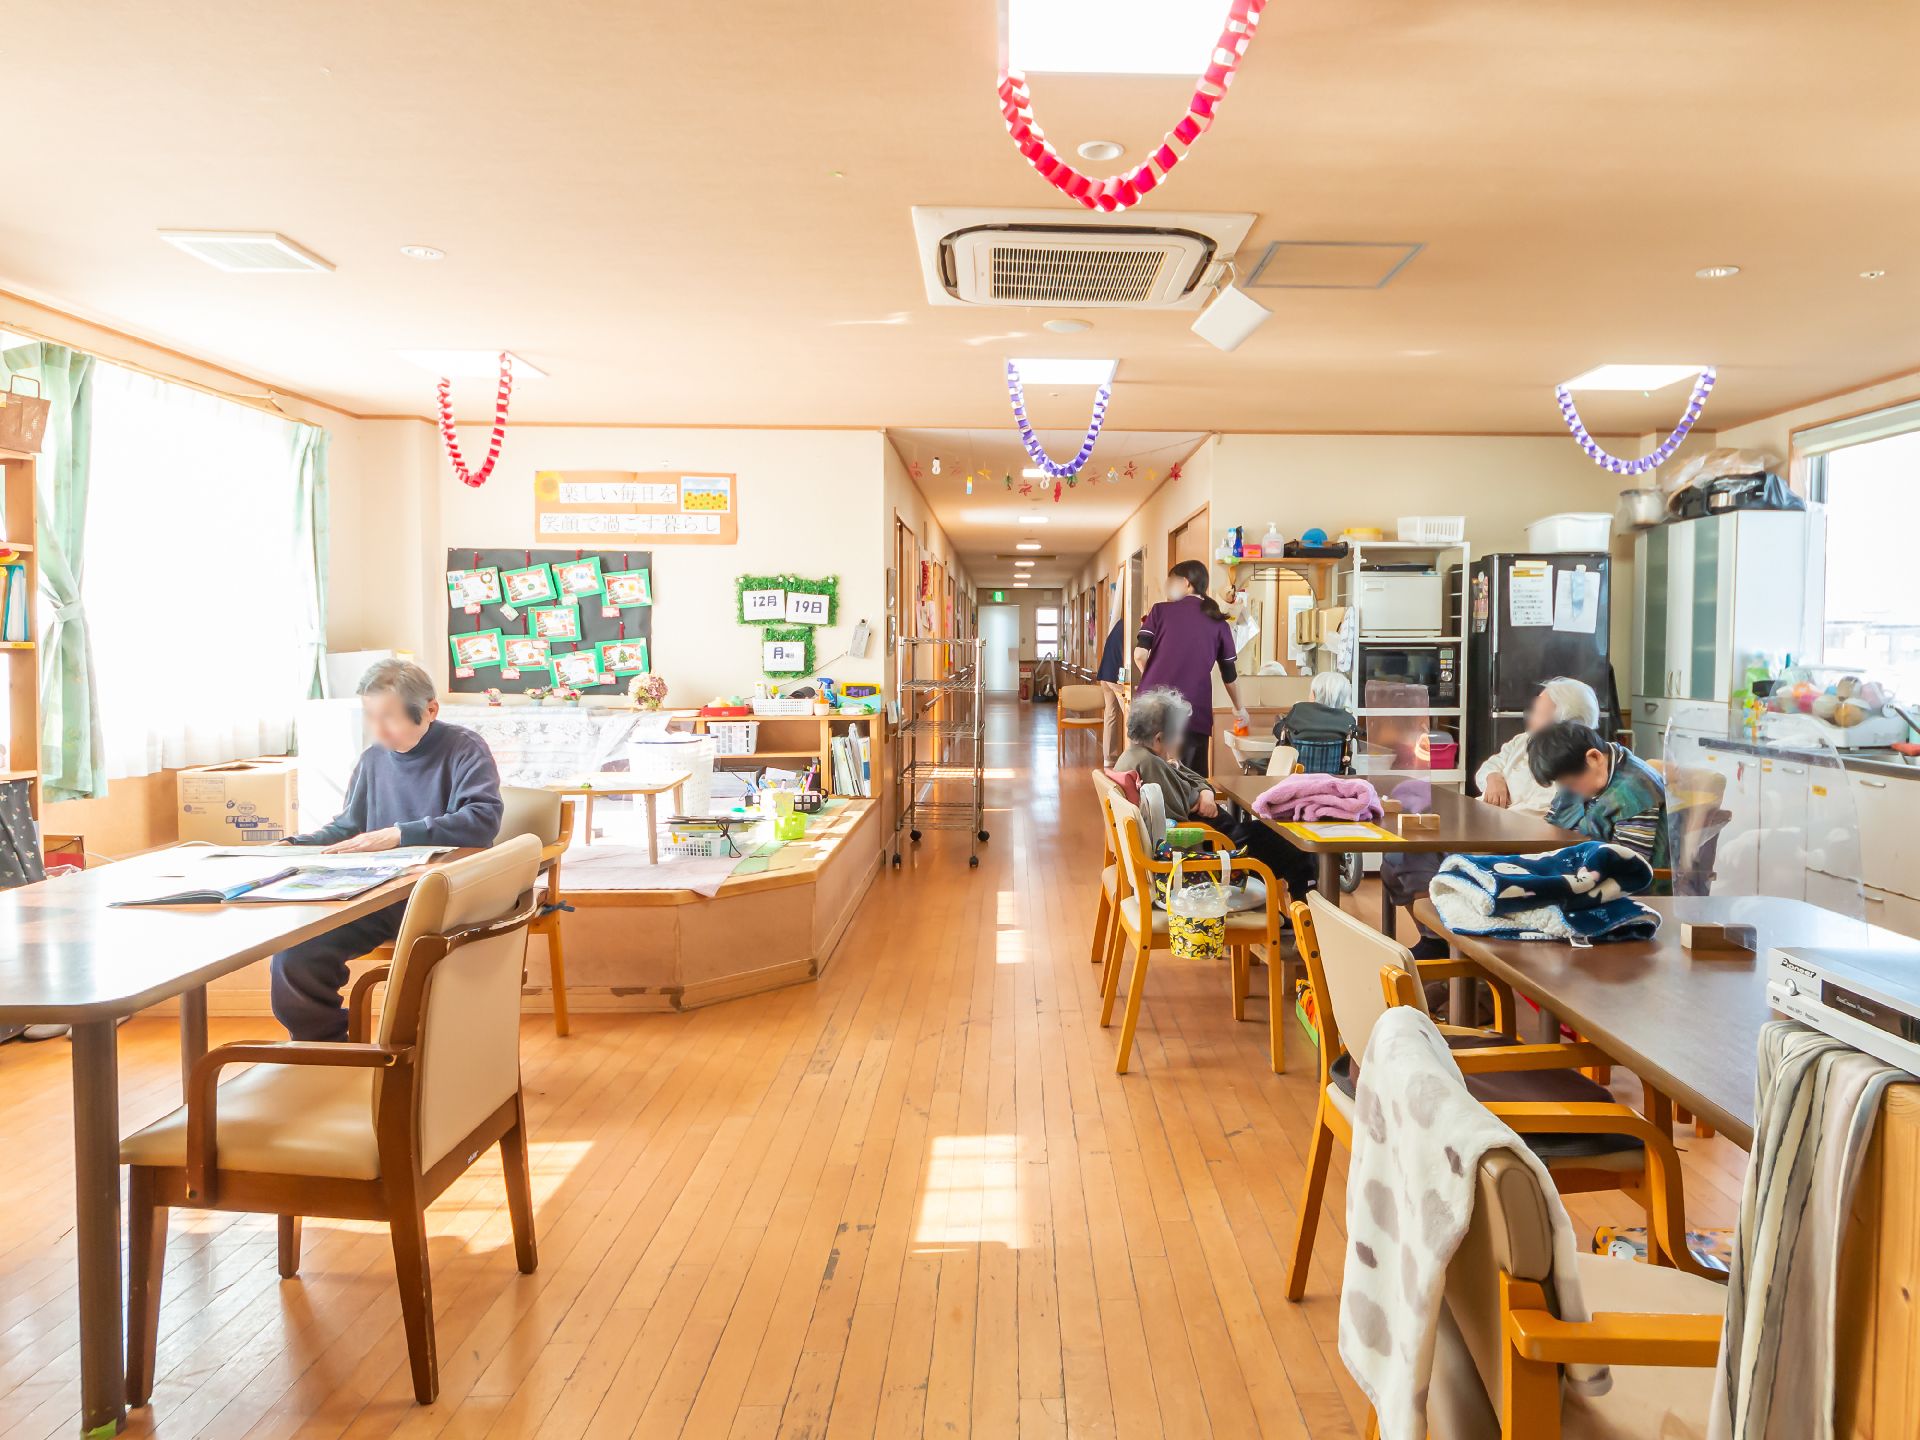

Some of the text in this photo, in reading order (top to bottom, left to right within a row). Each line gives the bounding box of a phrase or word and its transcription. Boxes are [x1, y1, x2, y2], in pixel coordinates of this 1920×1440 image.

[562, 484, 676, 503] 楽しい毎日を
[543, 514, 718, 533] 笑顔で過ごす暮らし
[752, 595, 777, 607] 12月
[794, 600, 822, 614] 19日
[1780, 957, 1817, 979] Pioneer
